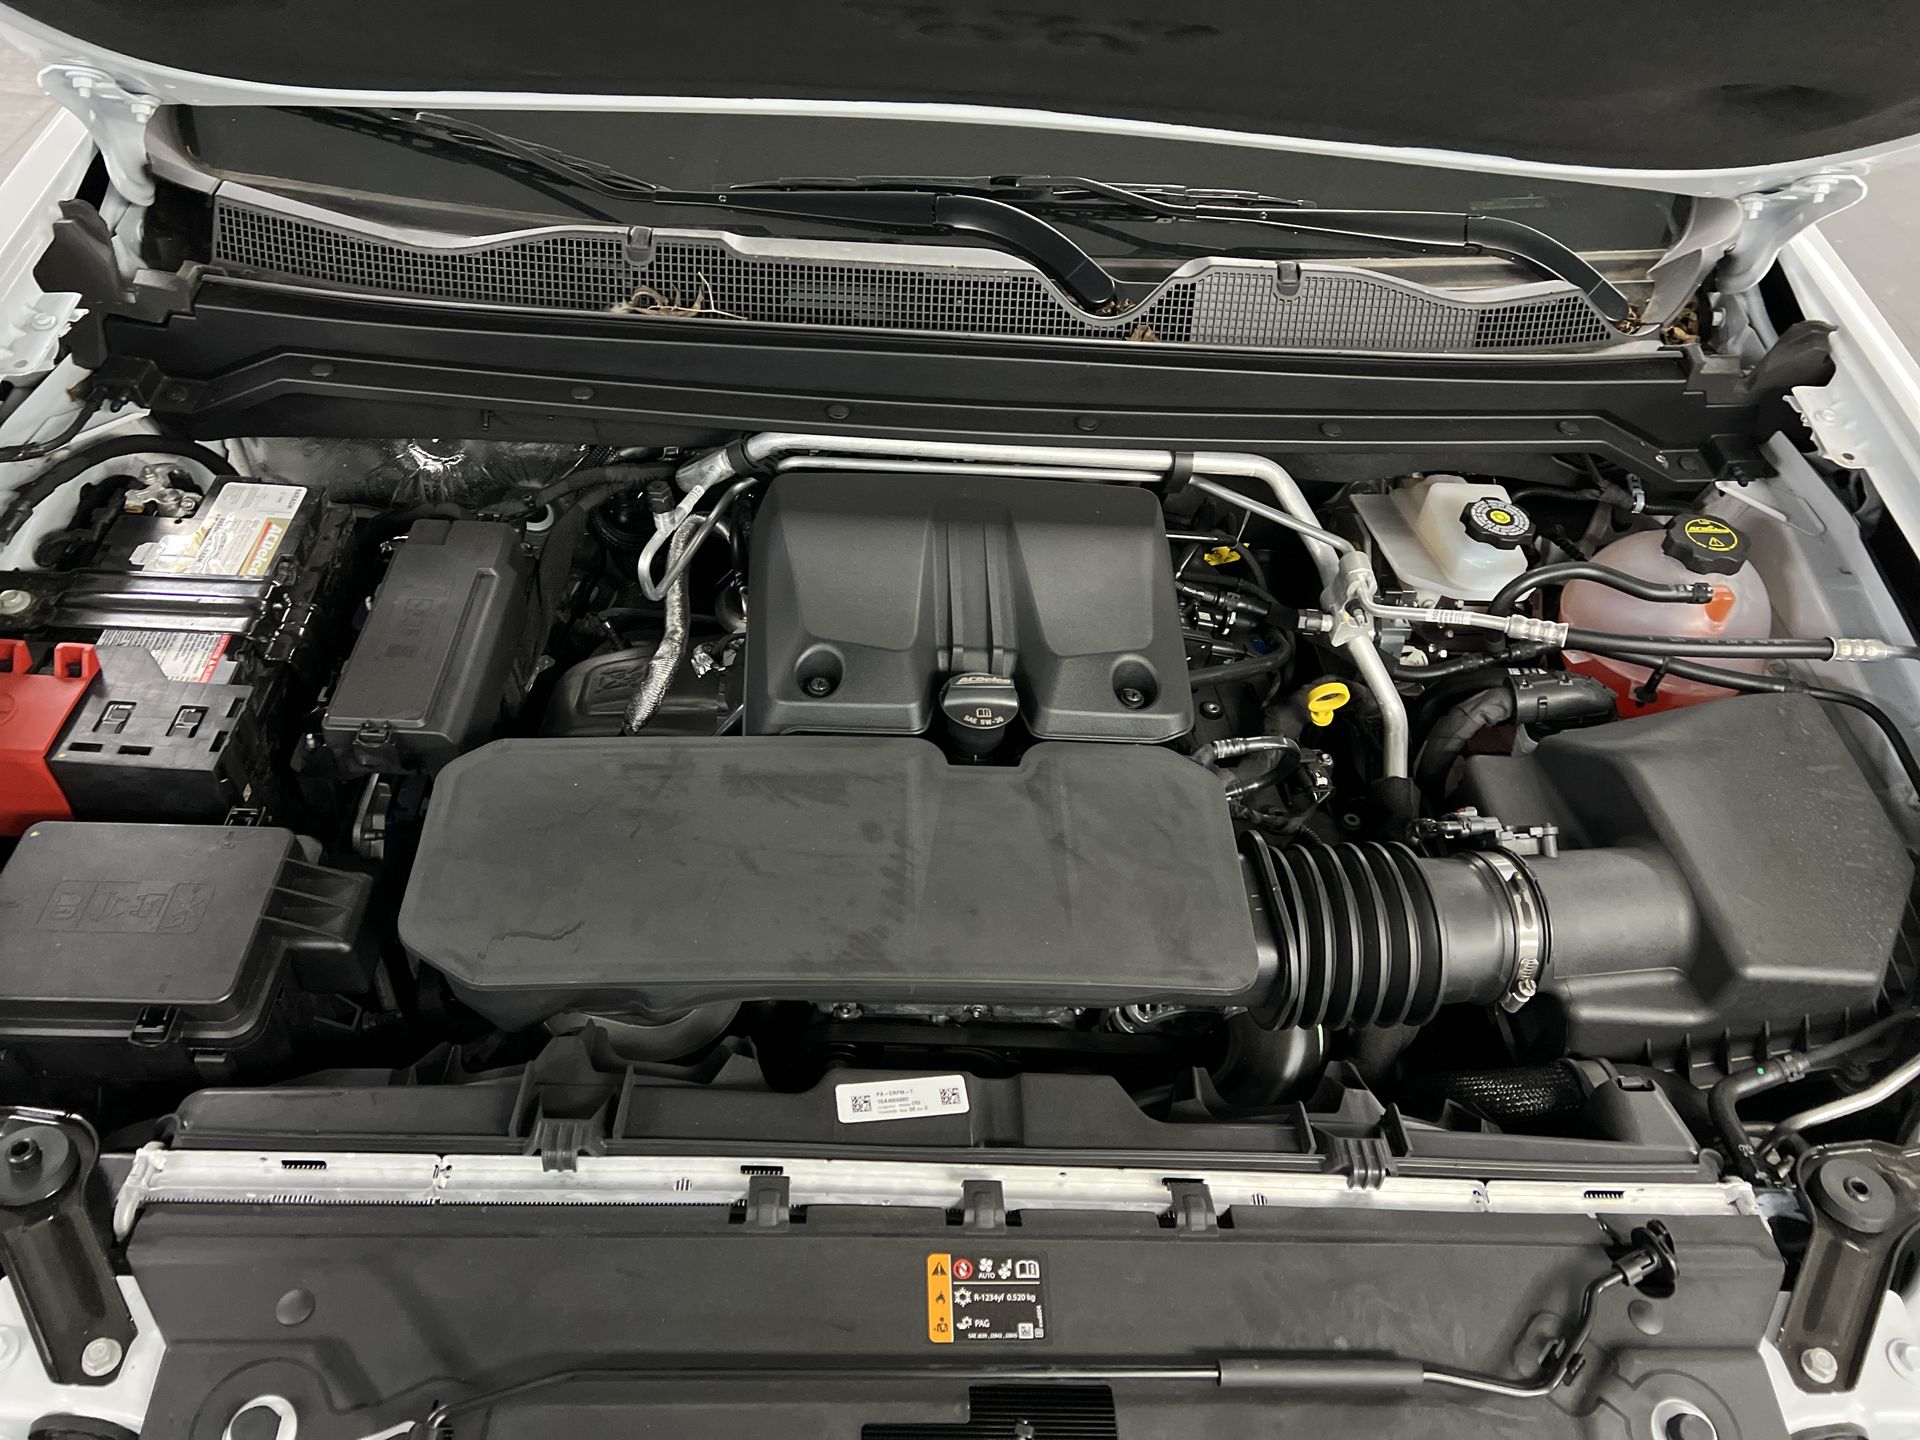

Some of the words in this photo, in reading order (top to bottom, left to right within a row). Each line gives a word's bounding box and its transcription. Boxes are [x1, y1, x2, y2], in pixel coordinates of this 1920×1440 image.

[246, 522, 282, 575] ACDelco
[956, 676, 1011, 685] ACDelco
[963, 715, 978, 725] SAE
[980, 716, 1004, 725] 5W-30
[973, 1293, 1004, 1303] R-1234yf
[1006, 1293, 1026, 1302] 0.520
[1026, 1293, 1036, 1303] kg
[974, 1319, 990, 1328] PAG
